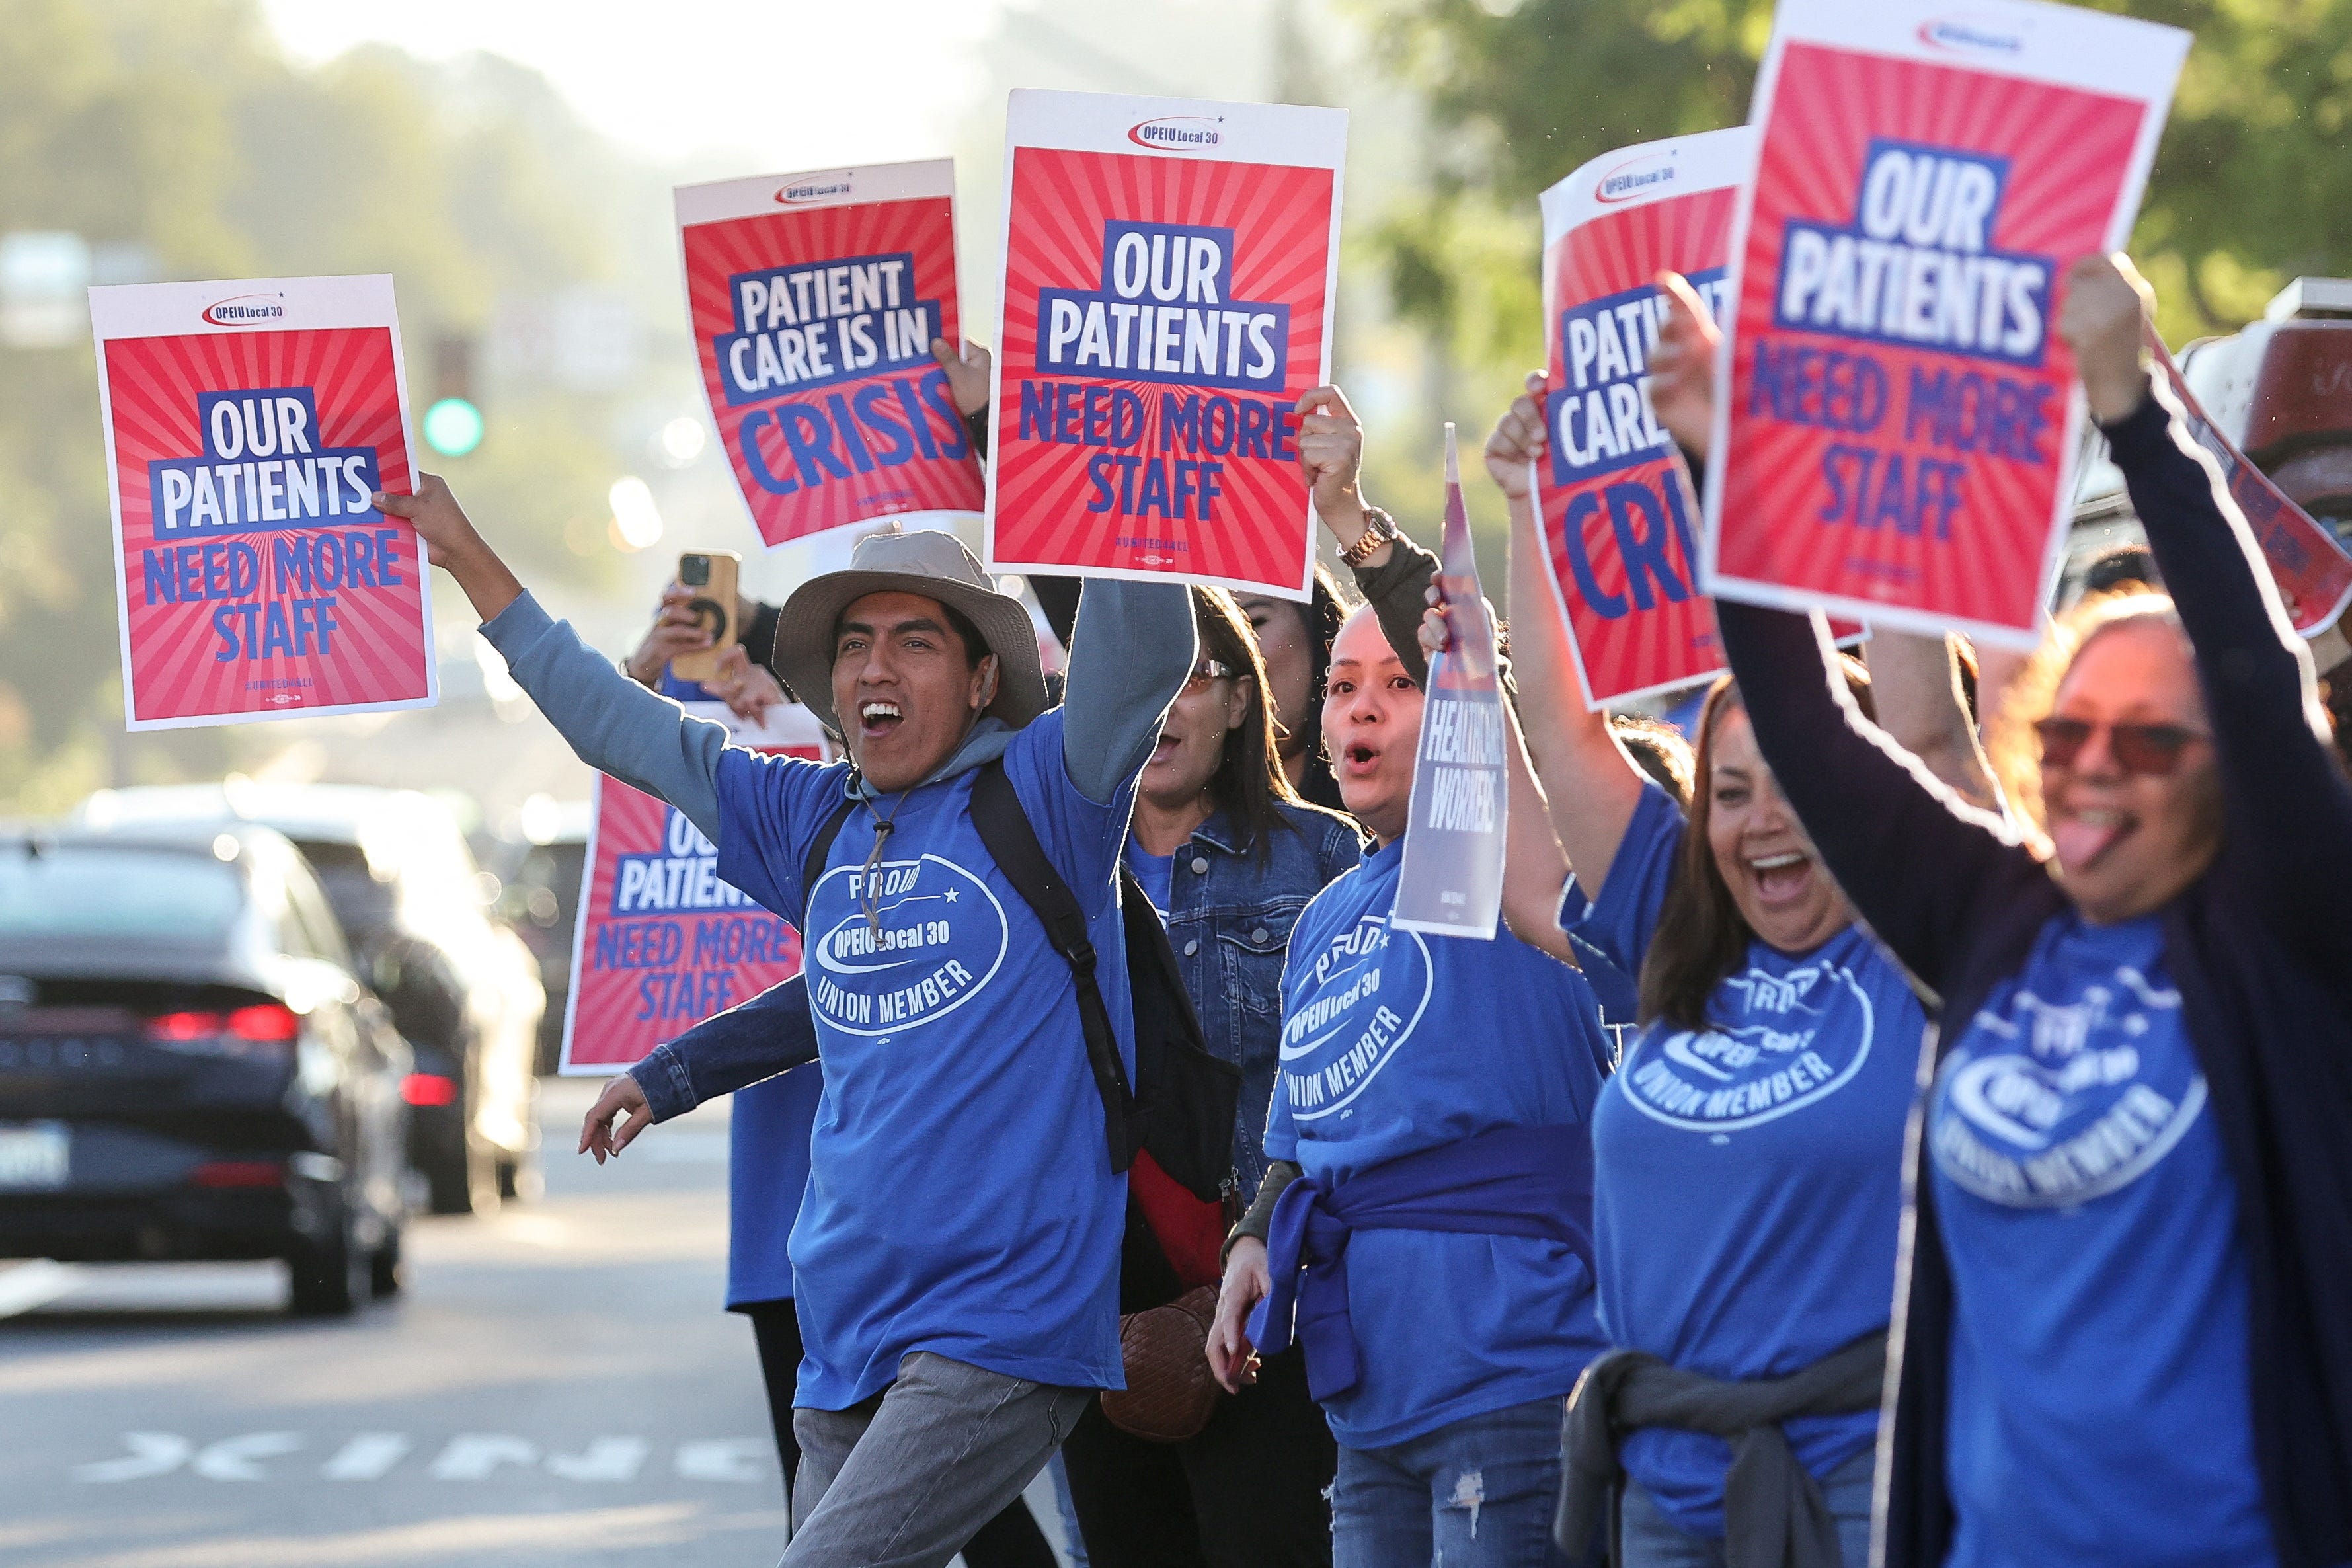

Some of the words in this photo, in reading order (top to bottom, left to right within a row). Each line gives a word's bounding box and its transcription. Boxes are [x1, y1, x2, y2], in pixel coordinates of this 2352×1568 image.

[1144, 125, 1176, 141] OPEIU
[1177, 130, 1203, 143] Local
[1205, 132, 1218, 144] 30
[1862, 149, 1998, 249] OUR
[740, 260, 904, 334] PATIENT
[1113, 231, 1222, 304] OUR
[1782, 228, 2047, 358] PATIENTS
[216, 306, 245, 319] OPEIU
[245, 307, 269, 317] Local
[270, 306, 282, 317] 30
[1048, 298, 1277, 380] PATIENTS
[728, 323, 834, 393] CARE
[836, 313, 879, 372] IS
[886, 307, 929, 362] IN
[210, 397, 313, 460] OUR
[738, 368, 968, 496] CRISIS
[1019, 379, 1142, 450] NEED
[1160, 391, 1299, 461] MORE
[1750, 340, 1889, 434] NEED
[1904, 364, 2055, 465] MORE
[161, 456, 374, 529] PATIENTS
[1087, 453, 1224, 522] STAFF
[1821, 444, 1968, 537] STAFF
[143, 542, 258, 606] NEED
[274, 529, 403, 595] MORE
[1564, 468, 1704, 619] CRI
[213, 596, 337, 662] STAFF
[617, 857, 756, 911] PATIE
[594, 921, 683, 971] NEED
[694, 918, 790, 967] MORE
[834, 926, 876, 959] OPEIU
[878, 923, 923, 952] Local
[927, 920, 950, 945] 30
[636, 969, 736, 1021] STAFF
[817, 975, 871, 1024] UNION
[878, 959, 974, 1024] MEMBER
[1290, 998, 1331, 1044] OPEIU
[1362, 968, 1381, 998] 30
[1325, 1004, 1403, 1098] MEMBER
[1704, 1051, 1835, 1118] MEMBER
